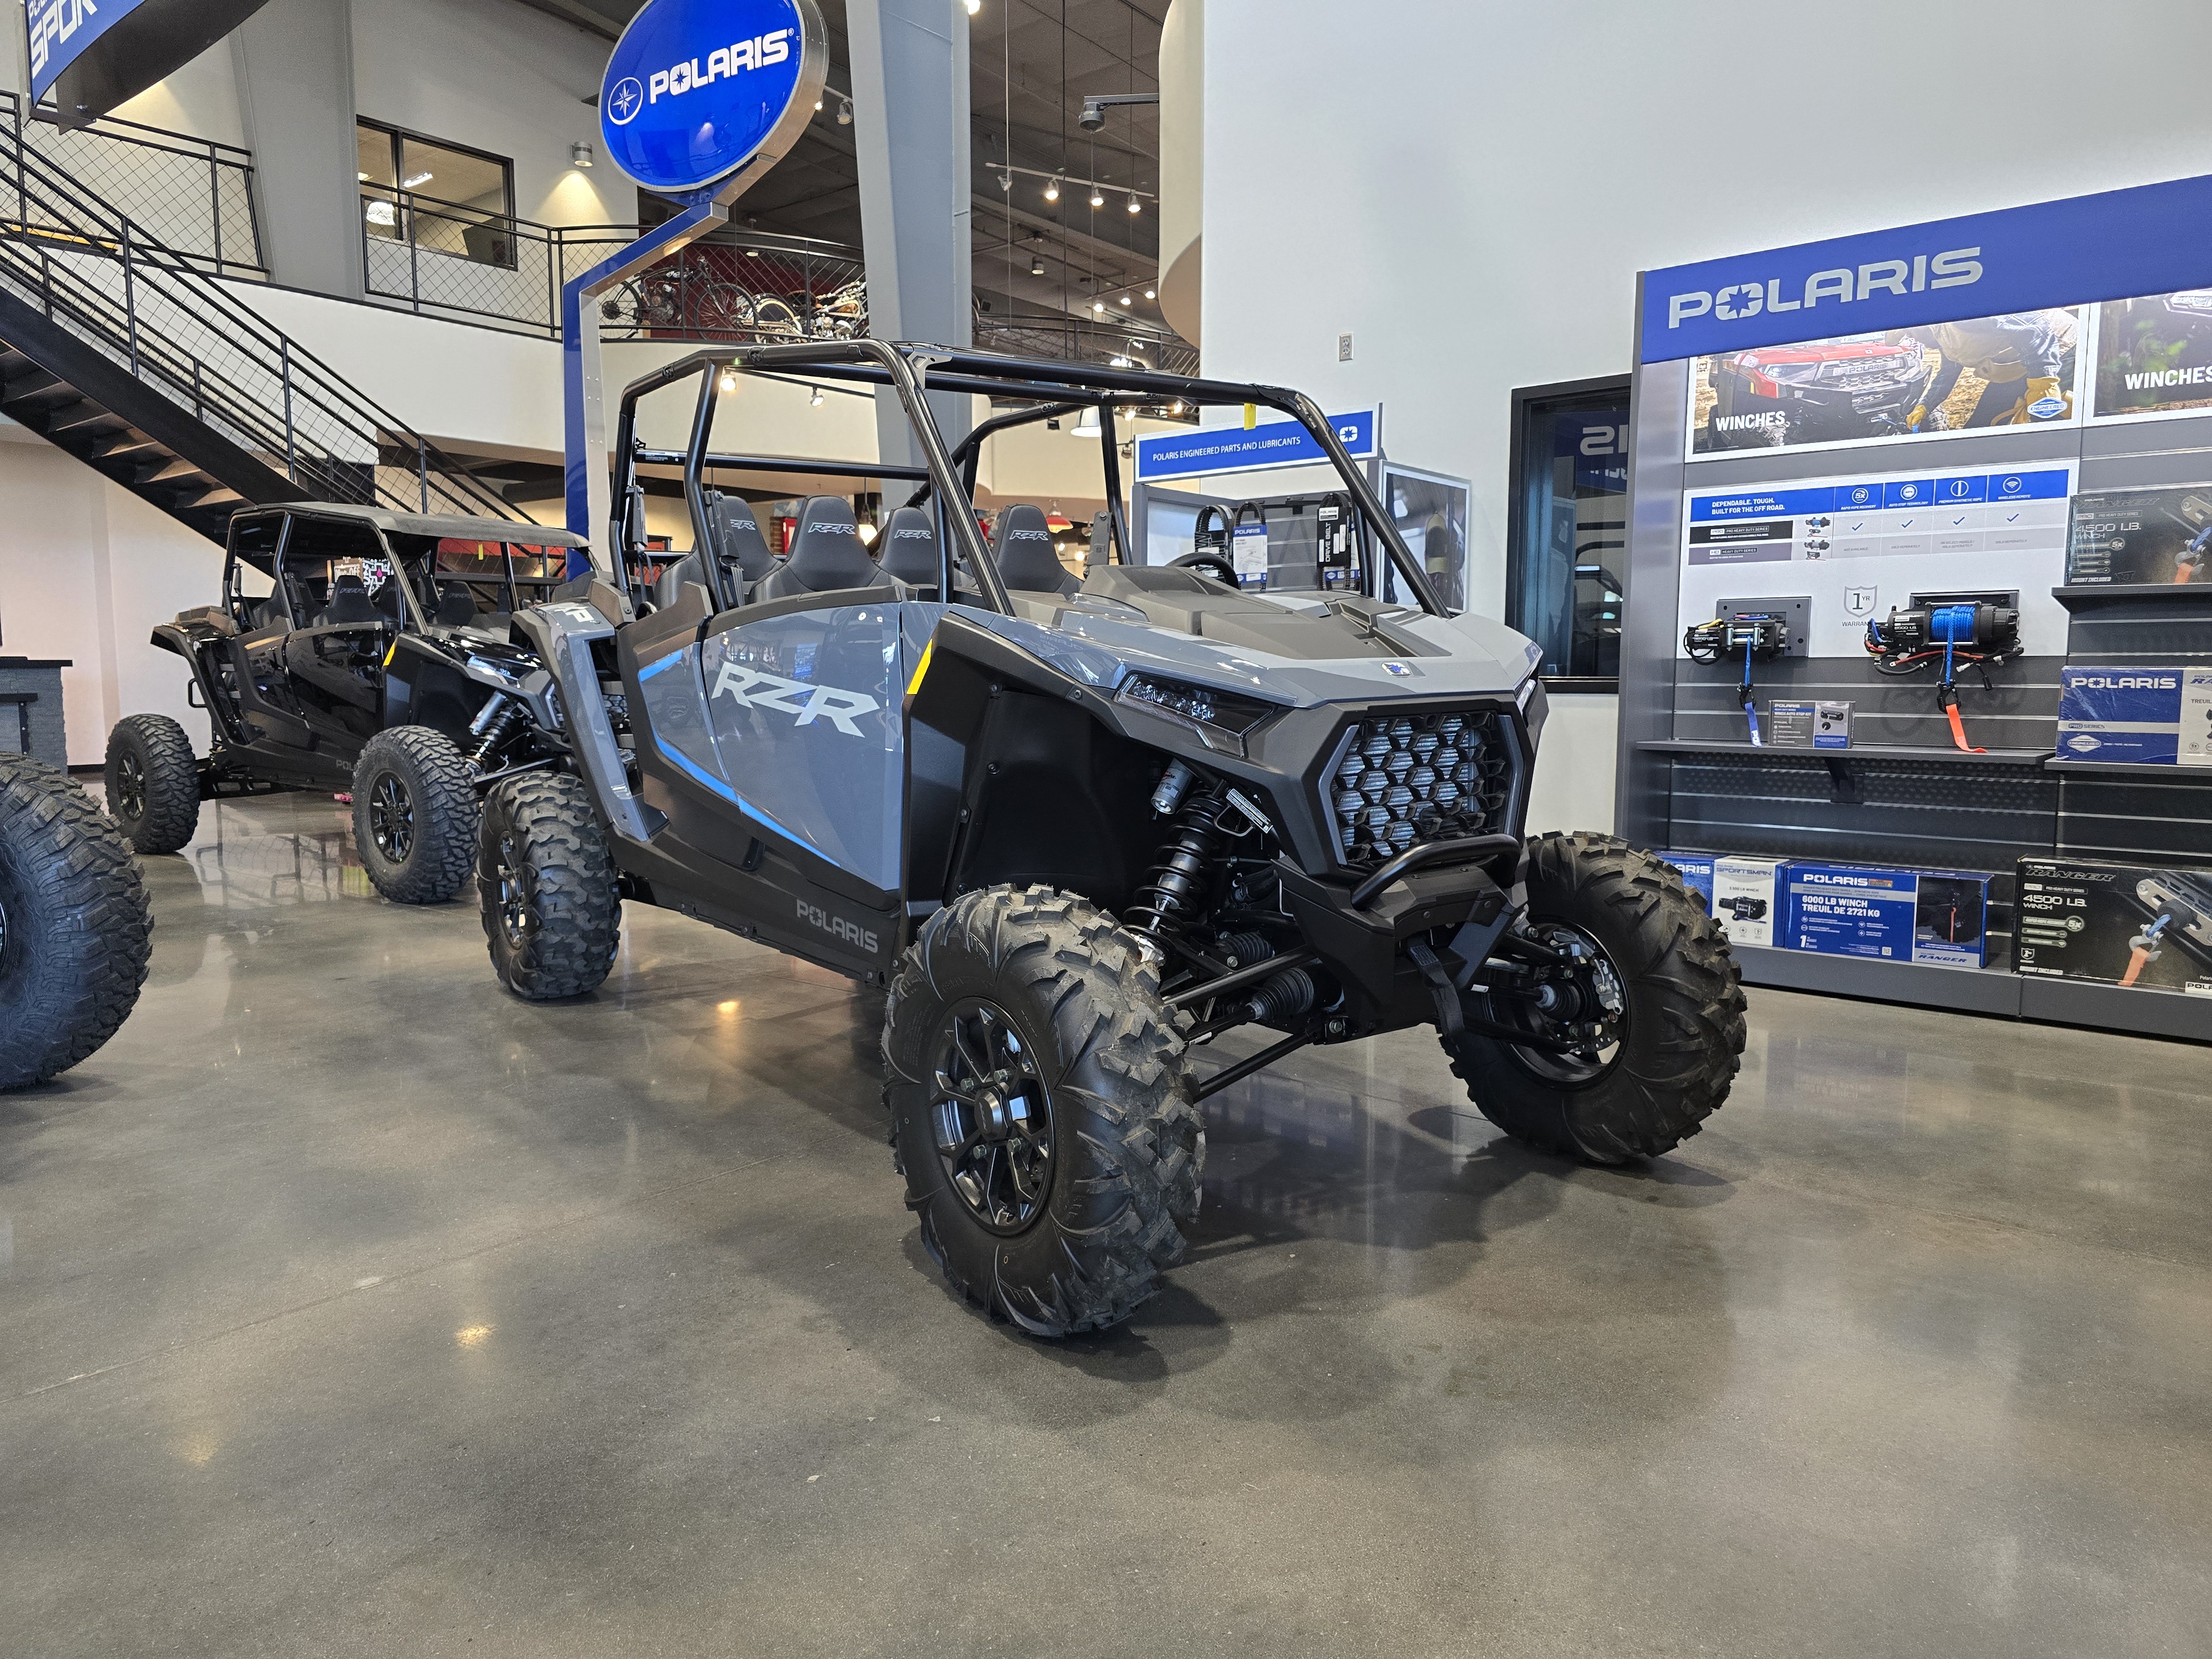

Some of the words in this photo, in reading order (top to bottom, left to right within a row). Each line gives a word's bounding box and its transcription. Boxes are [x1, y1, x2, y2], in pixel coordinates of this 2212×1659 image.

[650, 29, 789, 104] POLARIS
[1668, 247, 1983, 329] POLARIS
[1849, 363, 1887, 373] POLARIS
[1715, 410, 1786, 431] WINCHES
[1153, 452, 1179, 461] POLARIS
[1180, 446, 1220, 458] ENGINEERED
[1220, 444, 1241, 453] PARTS
[1241, 442, 1257, 451] AND
[1258, 436, 1301, 449] LUBRICANTS
[1712, 499, 1752, 507] DEPENDABLE.
[808, 522, 855, 535] RZR
[894, 529, 931, 539] RZR
[2075, 523, 2116, 533] 4500
[2120, 523, 2141, 531] LB.
[1009, 530, 1048, 541] RZR
[1853, 593, 1863, 610] 1
[2070, 677, 2177, 689] POLARIS
[711, 661, 880, 738] RZR
[1674, 864, 1710, 874] ARIS
[1716, 867, 1772, 876] SPORTSMAN
[2026, 869, 2115, 881] RANGER
[1803, 874, 1868, 886] POLARIS
[1802, 895, 1824, 904] 6000
[1825, 896, 1837, 905] LB
[1838, 898, 1867, 907] WINCH
[2023, 894, 2063, 905] 4500
[2066, 898, 2087, 907] LB.
[1802, 904, 1833, 913] TREUIL
[1834, 906, 1845, 914] DE
[1846, 907, 1866, 916] 2721
[1867, 909, 1880, 917] KG
[796, 898, 878, 953] POLARIS
